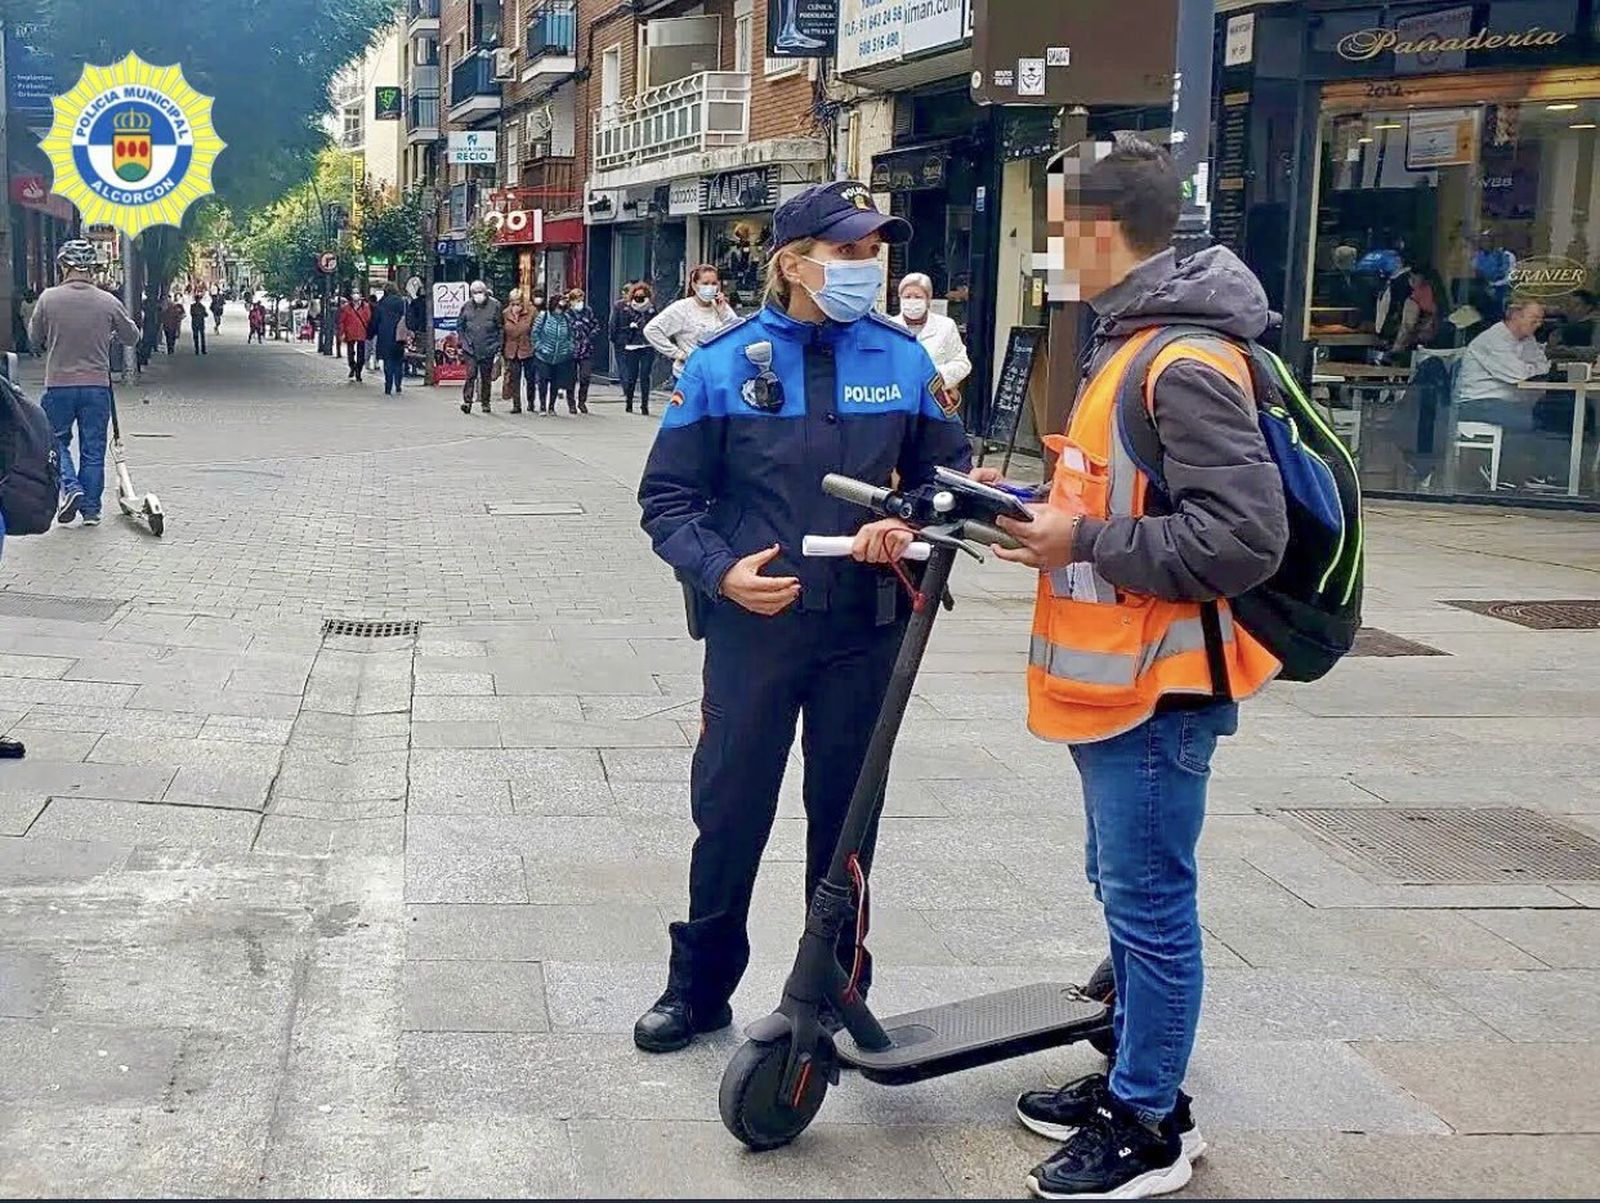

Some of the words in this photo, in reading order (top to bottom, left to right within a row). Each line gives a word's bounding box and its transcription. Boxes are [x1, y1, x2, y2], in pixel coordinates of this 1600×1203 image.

[1336, 26, 1566, 61] Panadería
[456, 152, 488, 161] RECIO
[1508, 268, 1584, 282] GRANIER
[437, 284, 466, 303] 2x1
[844, 383, 902, 403] POLICIA
